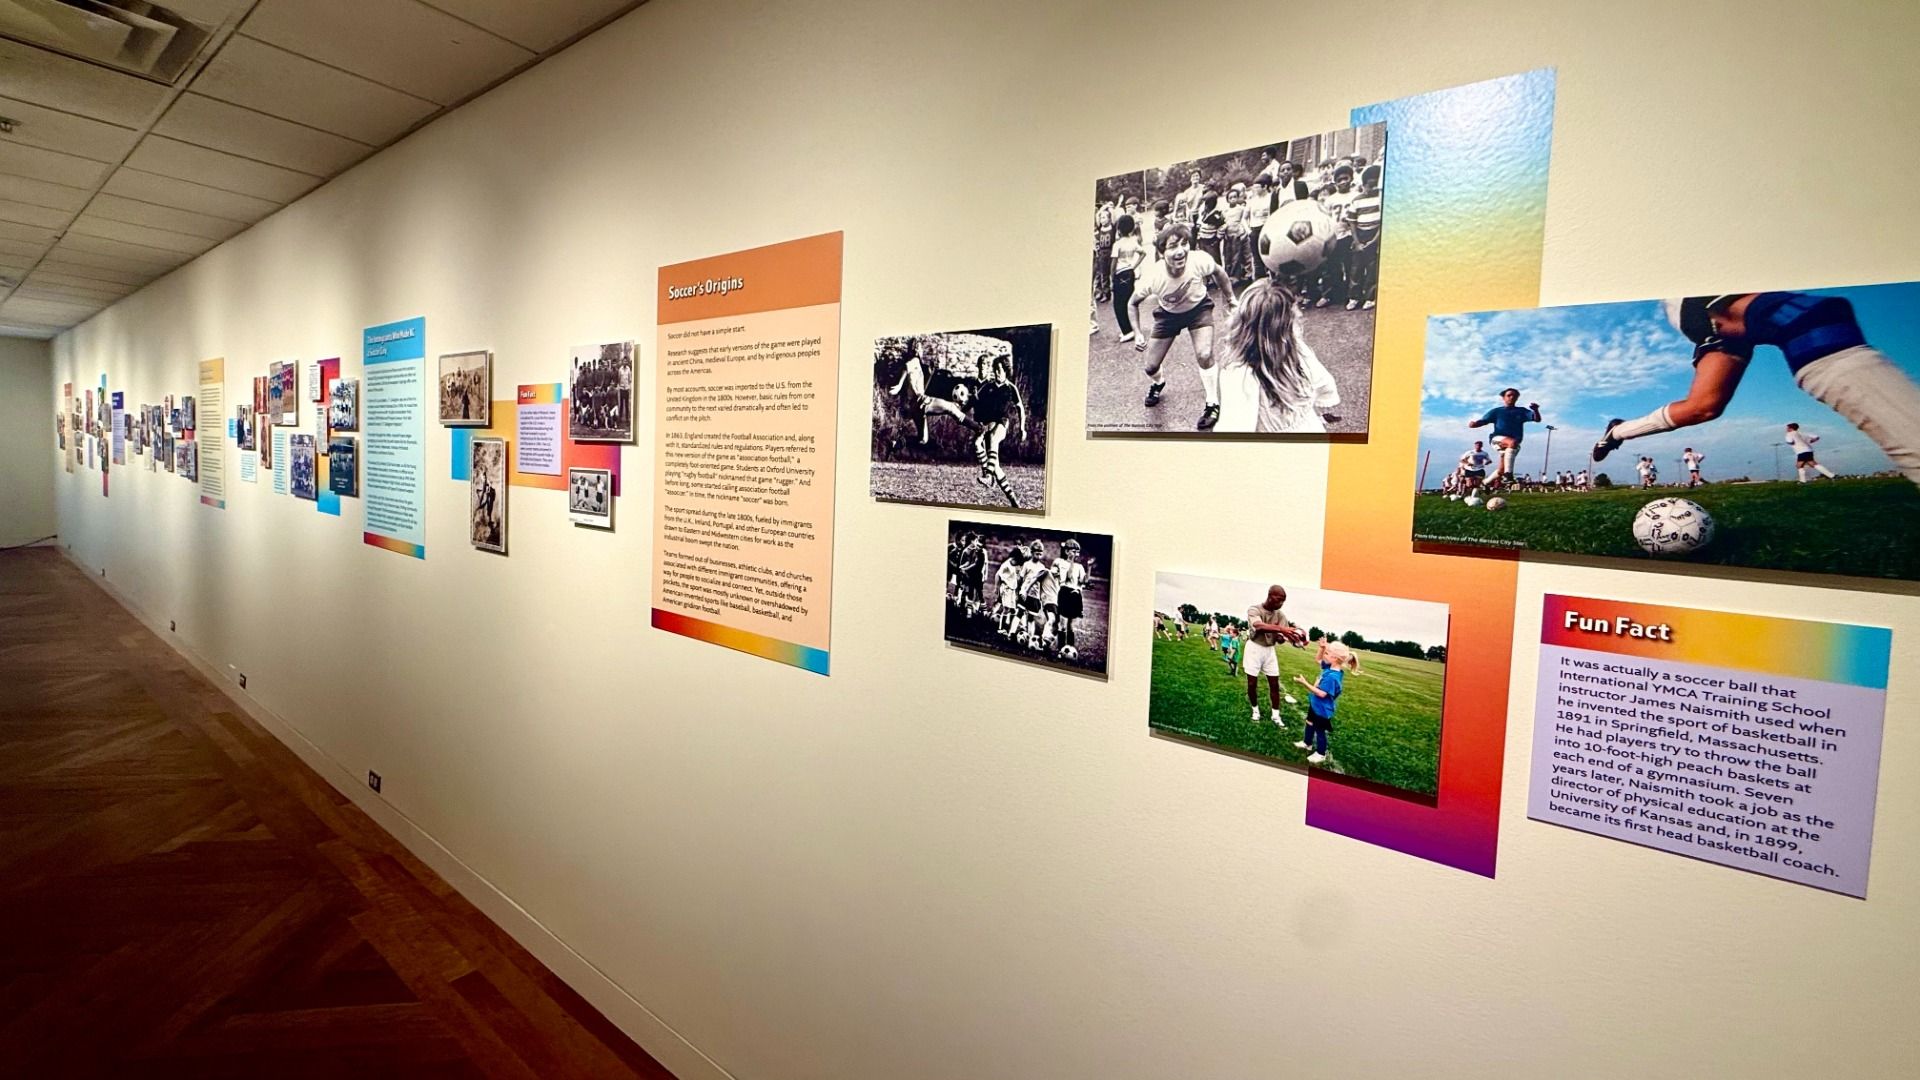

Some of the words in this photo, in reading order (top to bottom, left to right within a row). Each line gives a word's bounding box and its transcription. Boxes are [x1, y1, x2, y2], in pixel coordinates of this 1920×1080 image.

[669, 280, 704, 299] Soccer's
[705, 274, 744, 297] Origins
[761, 341, 770, 349] the
[771, 341, 786, 350] game
[801, 337, 821, 348] played
[797, 348, 820, 360] peoples
[776, 381, 786, 389] U.S.
[802, 380, 813, 388] the
[774, 392, 788, 400] rules
[785, 434, 797, 442] and,
[798, 434, 815, 444] along
[765, 444, 785, 454] Players
[766, 465, 785, 473] Oxford
[786, 467, 815, 478] University
[799, 478, 811, 486] And
[781, 518, 812, 531] immigrants
[761, 526, 787, 539] European
[788, 530, 815, 540] countries
[763, 537, 776, 546] work
[784, 540, 794, 548] the
[775, 569, 785, 577] and
[786, 571, 812, 582] churches
[780, 580, 802, 594] offering
[765, 588, 785, 599] outside
[786, 592, 802, 602] those
[761, 598, 800, 612] overshadowed
[781, 613, 792, 622] and
[1565, 610, 1609, 634] Fun
[1615, 616, 1671, 642] Fact
[1560, 656, 1571, 667] It
[1573, 660, 1600, 671] was
[1602, 662, 1659, 682] actually
[1662, 672, 1671, 681] a
[1674, 674, 1725, 689] soccer
[1728, 679, 1758, 694] ball
[1761, 684, 1797, 699] that
[1559, 669, 1649, 692] International
[1652, 682, 1699, 699] YMCA
[1702, 690, 1768, 713] Training
[1772, 700, 1831, 720] School
[1558, 682, 1626, 703] instructor
[1629, 693, 1676, 711] James
[1680, 701, 1751, 723] Naismith
[1755, 713, 1795, 730] used
[1799, 719, 1847, 738] when
[1557, 696, 1574, 708] he
[1577, 699, 1637, 718] invented
[1640, 709, 1664, 723] the
[1667, 714, 1708, 733] sport
[1711, 721, 1728, 734] of
[1732, 724, 1817, 749] basketball
[1821, 739, 1838, 752] in
[1556, 709, 1592, 724] 1891
[1595, 715, 1608, 727] in
[1611, 718, 1695, 745] Springfield,
[1698, 733, 1825, 765] Massachusetts.
[1555, 722, 1574, 735] He
[1577, 726, 1603, 740] had
[1605, 731, 1657, 753] players
[1660, 741, 1681, 757] try
[1684, 745, 1700, 758] to
[1704, 749, 1751, 767] throw
[1755, 758, 1782, 773] the
[1786, 763, 1817, 780] ball
[1554, 735, 1581, 749] into
[1584, 740, 1674, 770] 10-foot-high
[1677, 758, 1724, 780] peach
[1727, 767, 1791, 790] baskets
[1794, 780, 1813, 794] at
[1553, 748, 1585, 764] each
[1588, 755, 1614, 770] end
[1617, 761, 1633, 773] of
[1635, 766, 1644, 776] a
[1647, 767, 1741, 798] gymnasium.
[1744, 785, 1794, 806] Seven
[1552, 763, 1588, 781] years
[1591, 769, 1625, 787] later,
[1628, 777, 1695, 801] Naismith
[1699, 791, 1735, 809] took
[1738, 802, 1749, 812] a
[1752, 802, 1779, 821] job
[1783, 811, 1802, 823] as
[1805, 813, 1835, 830] the
[1551, 775, 1603, 795] director
[1606, 786, 1621, 799] of
[1624, 790, 1684, 816] physical
[1687, 803, 1767, 831] education
[1771, 821, 1788, 835] at
[1792, 825, 1821, 842] the
[1550, 788, 1618, 815] University
[1621, 803, 1637, 816] of
[1640, 807, 1693, 829] Kansas
[1697, 820, 1731, 839] and,
[1735, 828, 1751, 842] in
[1755, 833, 1803, 855] 1899,
[1549, 801, 1601, 822] became
[1604, 813, 1621, 827] its
[1624, 818, 1653, 834] first
[1656, 825, 1694, 844] head
[1697, 835, 1779, 864] basketball
[1782, 854, 1841, 878] coach.
